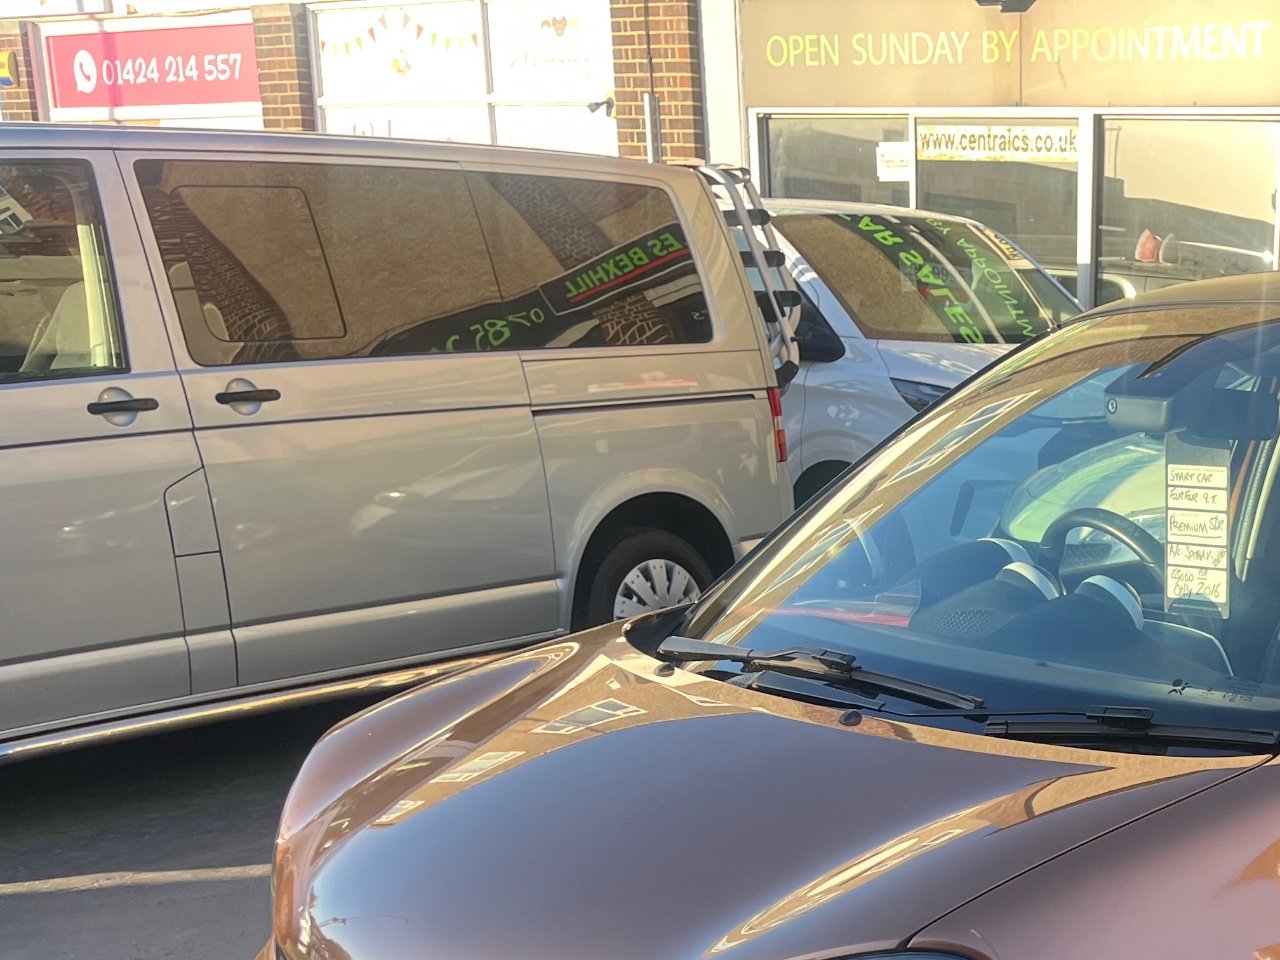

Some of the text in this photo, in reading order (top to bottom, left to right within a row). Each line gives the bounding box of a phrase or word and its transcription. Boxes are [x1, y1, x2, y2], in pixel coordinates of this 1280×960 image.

[765, 22, 1270, 67] OPEN SUNDAY BY APPOINTMENT
[102, 53, 242, 85] 01424 214 557
[919, 128, 1078, 153] www.centralcs.co.uk
[1195, 582, 1222, 598] 2016
